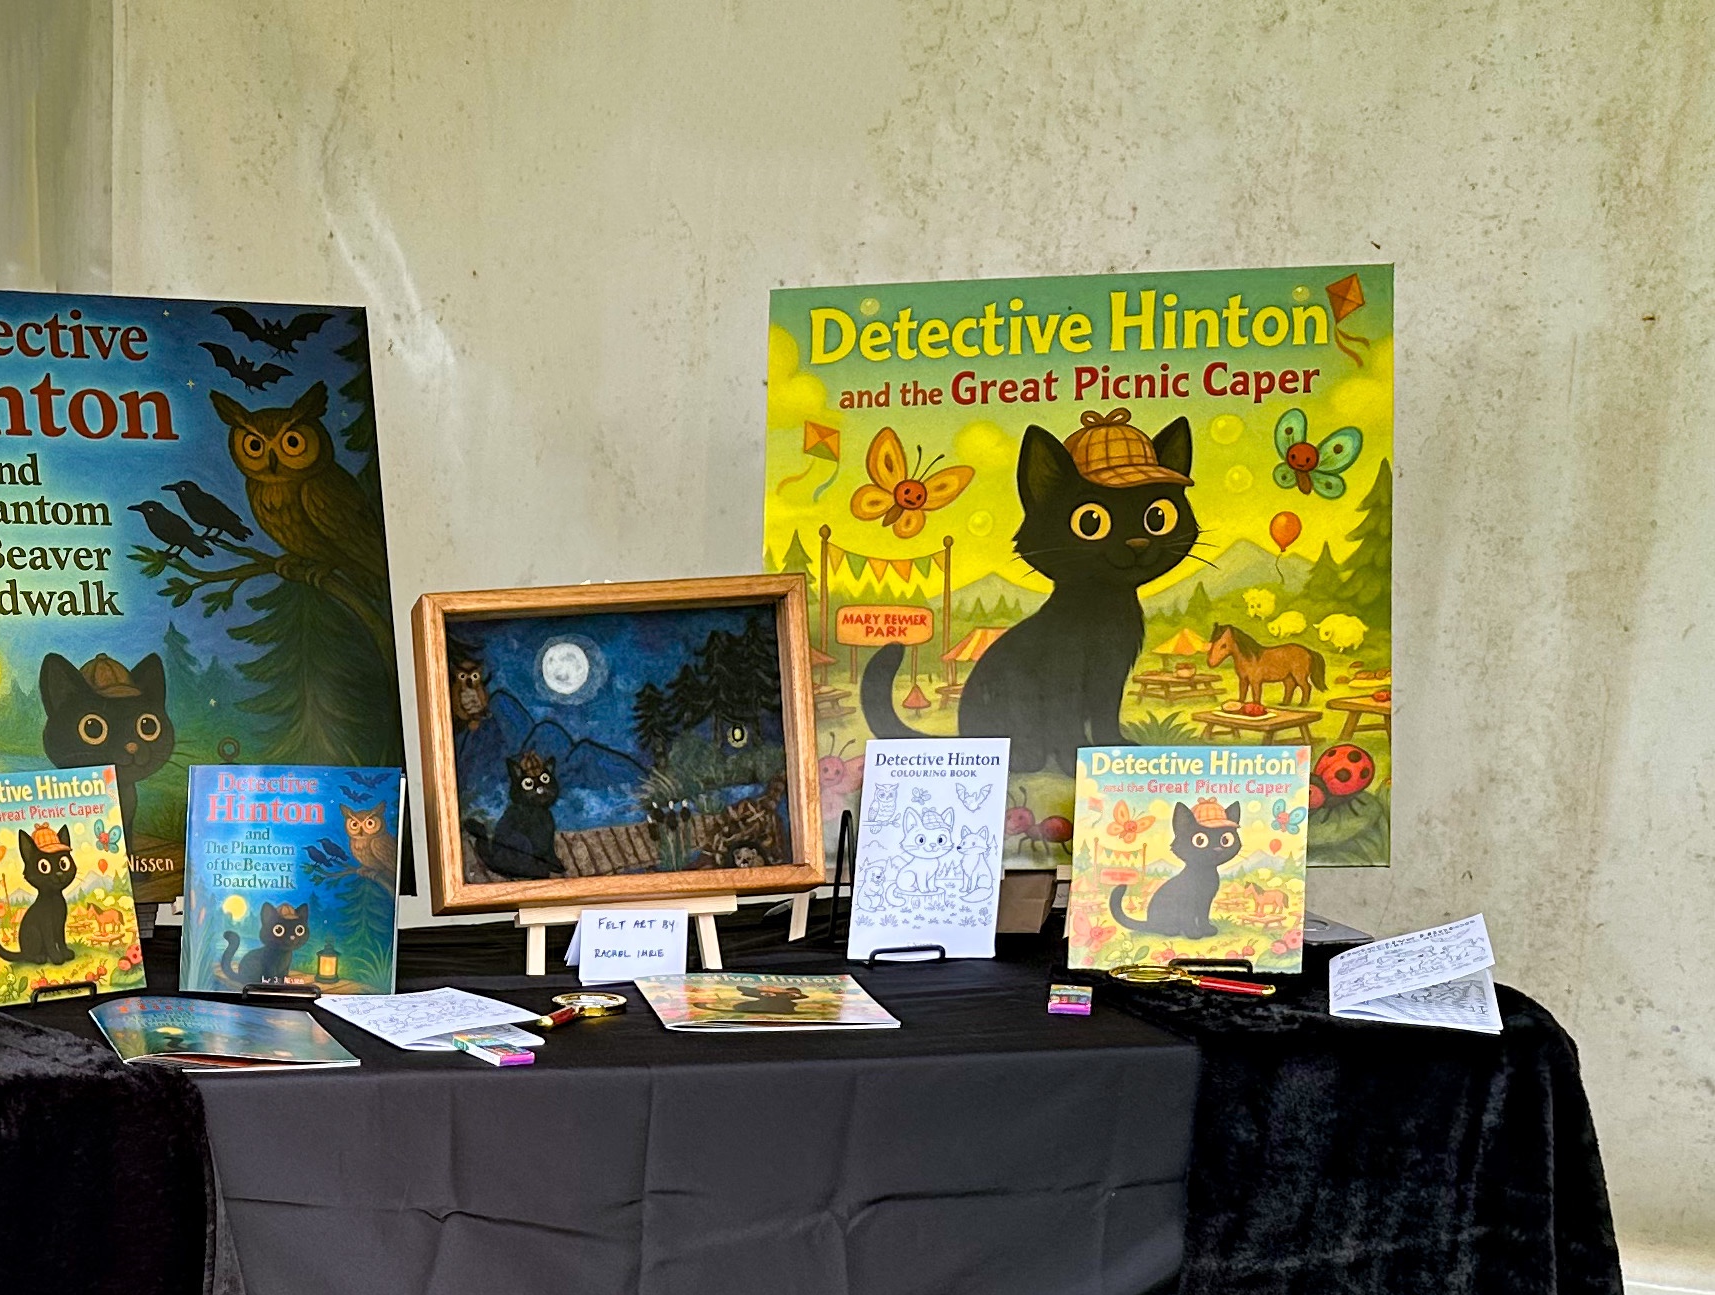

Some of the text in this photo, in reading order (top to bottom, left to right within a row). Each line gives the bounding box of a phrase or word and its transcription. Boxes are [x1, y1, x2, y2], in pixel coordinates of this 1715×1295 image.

[809, 289, 1329, 365] Detective Hinton
[839, 361, 1320, 410] and the Great Picnic Caper
[842, 613, 881, 625] MARY
[866, 626, 908, 637] PARK
[875, 752, 1000, 767] Detective Hinton
[1091, 750, 1296, 776] Detective Hinton
[891, 769, 977, 778] COLOURING BOOK
[35, 774, 106, 800] Hinton
[218, 772, 319, 793] Detective
[1147, 780, 1189, 794] Great
[1195, 779, 1241, 794] Picnic
[1245, 779, 1292, 797] Caper
[29, 805, 65, 820] Picnic
[69, 802, 105, 819] Caper
[206, 795, 325, 824] Hinton
[245, 827, 270, 841] and
[205, 841, 295, 856] The Phantom
[128, 854, 174, 872] Nissen
[206, 857, 293, 872] of the Beaver
[213, 873, 296, 890] Boardwalk
[598, 917, 675, 932] FELT ART BY
